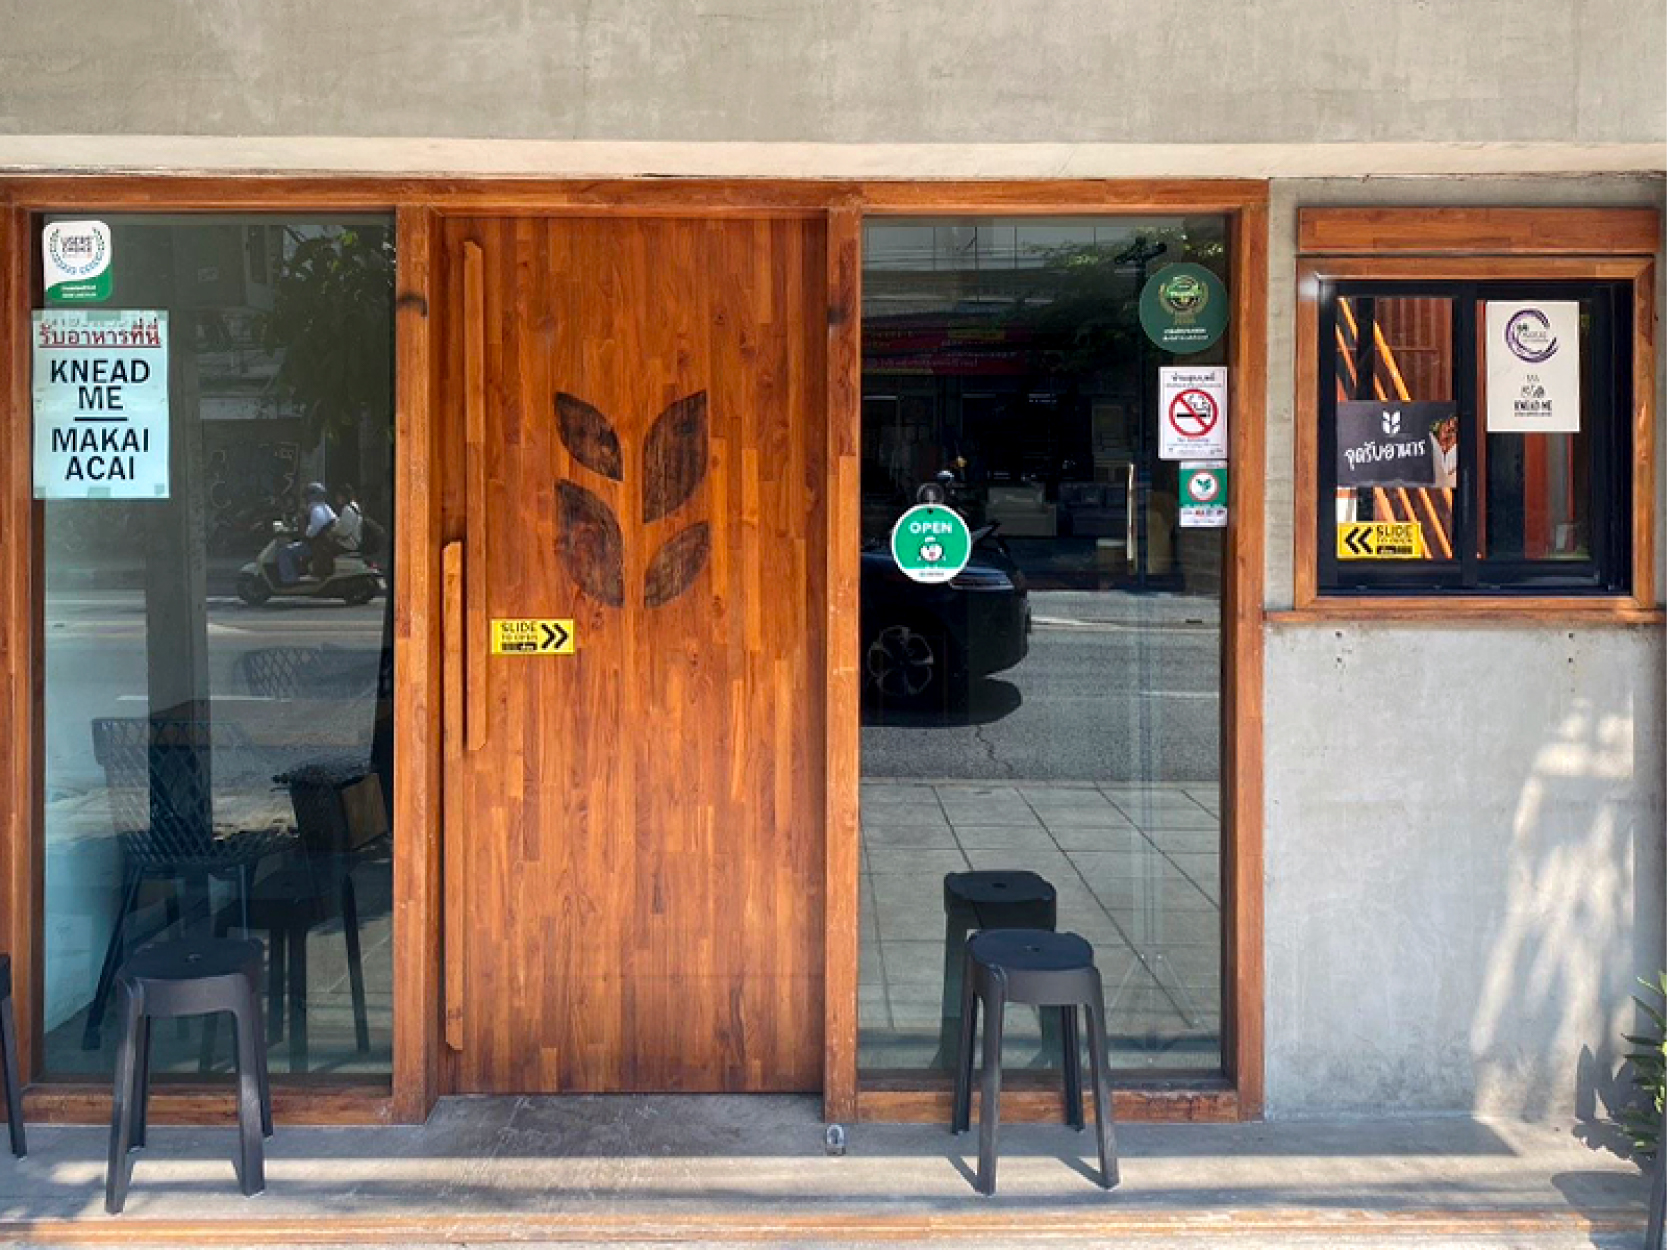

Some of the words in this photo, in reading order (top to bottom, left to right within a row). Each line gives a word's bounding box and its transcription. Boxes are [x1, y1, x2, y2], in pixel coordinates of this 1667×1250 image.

[39, 317, 160, 345] รับอาหารที่นี่
[50, 360, 150, 384] KNEAD
[78, 386, 124, 410] ME
[51, 428, 149, 453] MAKAI
[1343, 440, 1426, 472] จุดรับอาหาร
[64, 456, 134, 481] ACAI
[909, 521, 953, 534] OPEN
[1376, 525, 1414, 537] SLIDE
[500, 621, 538, 633] SLIDE
